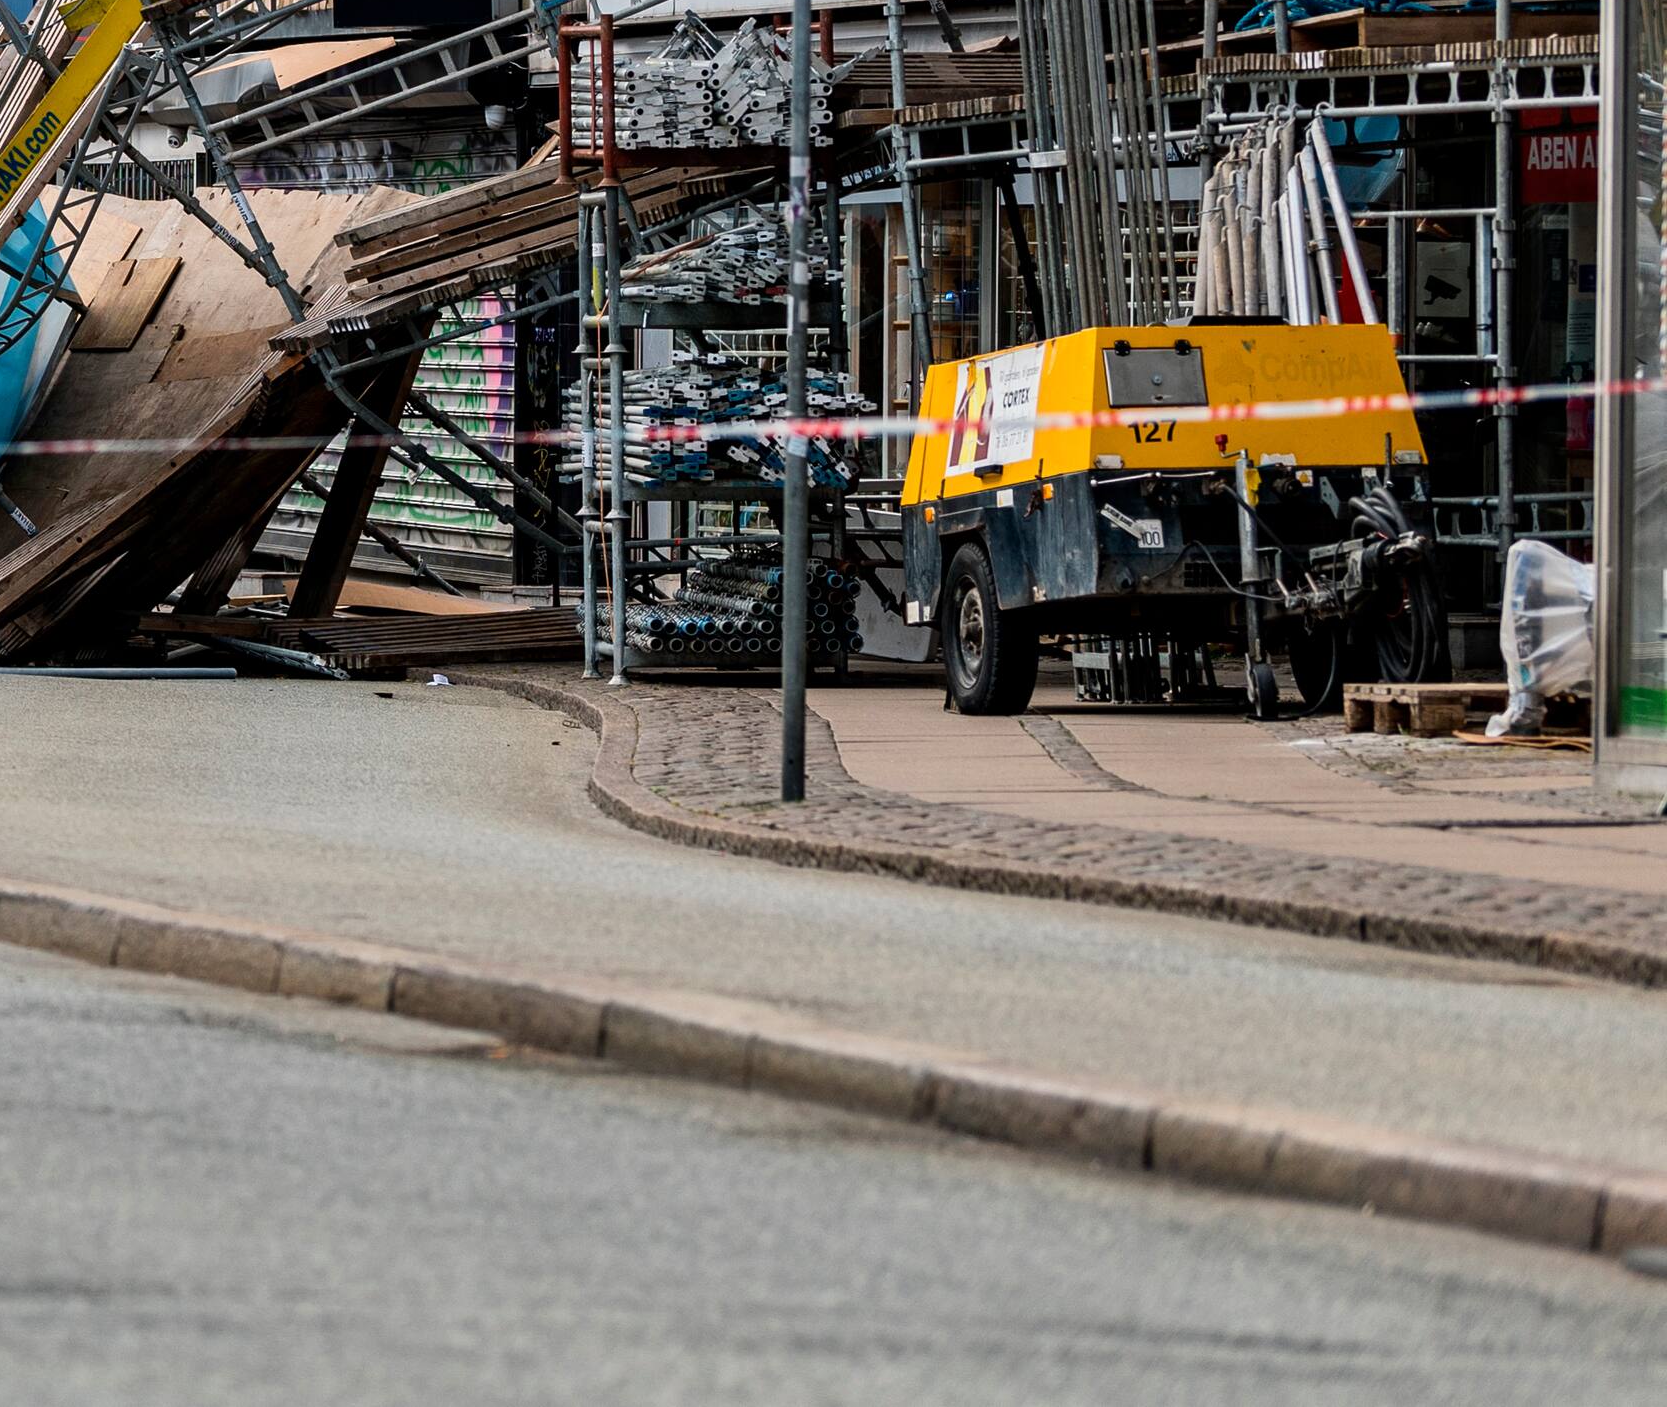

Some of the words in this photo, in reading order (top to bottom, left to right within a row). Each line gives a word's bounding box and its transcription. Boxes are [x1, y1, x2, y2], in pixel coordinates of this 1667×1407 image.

[1581, 134, 1598, 169] A
[1002, 386, 1031, 409] CORTEX
[1127, 419, 1178, 444] 127
